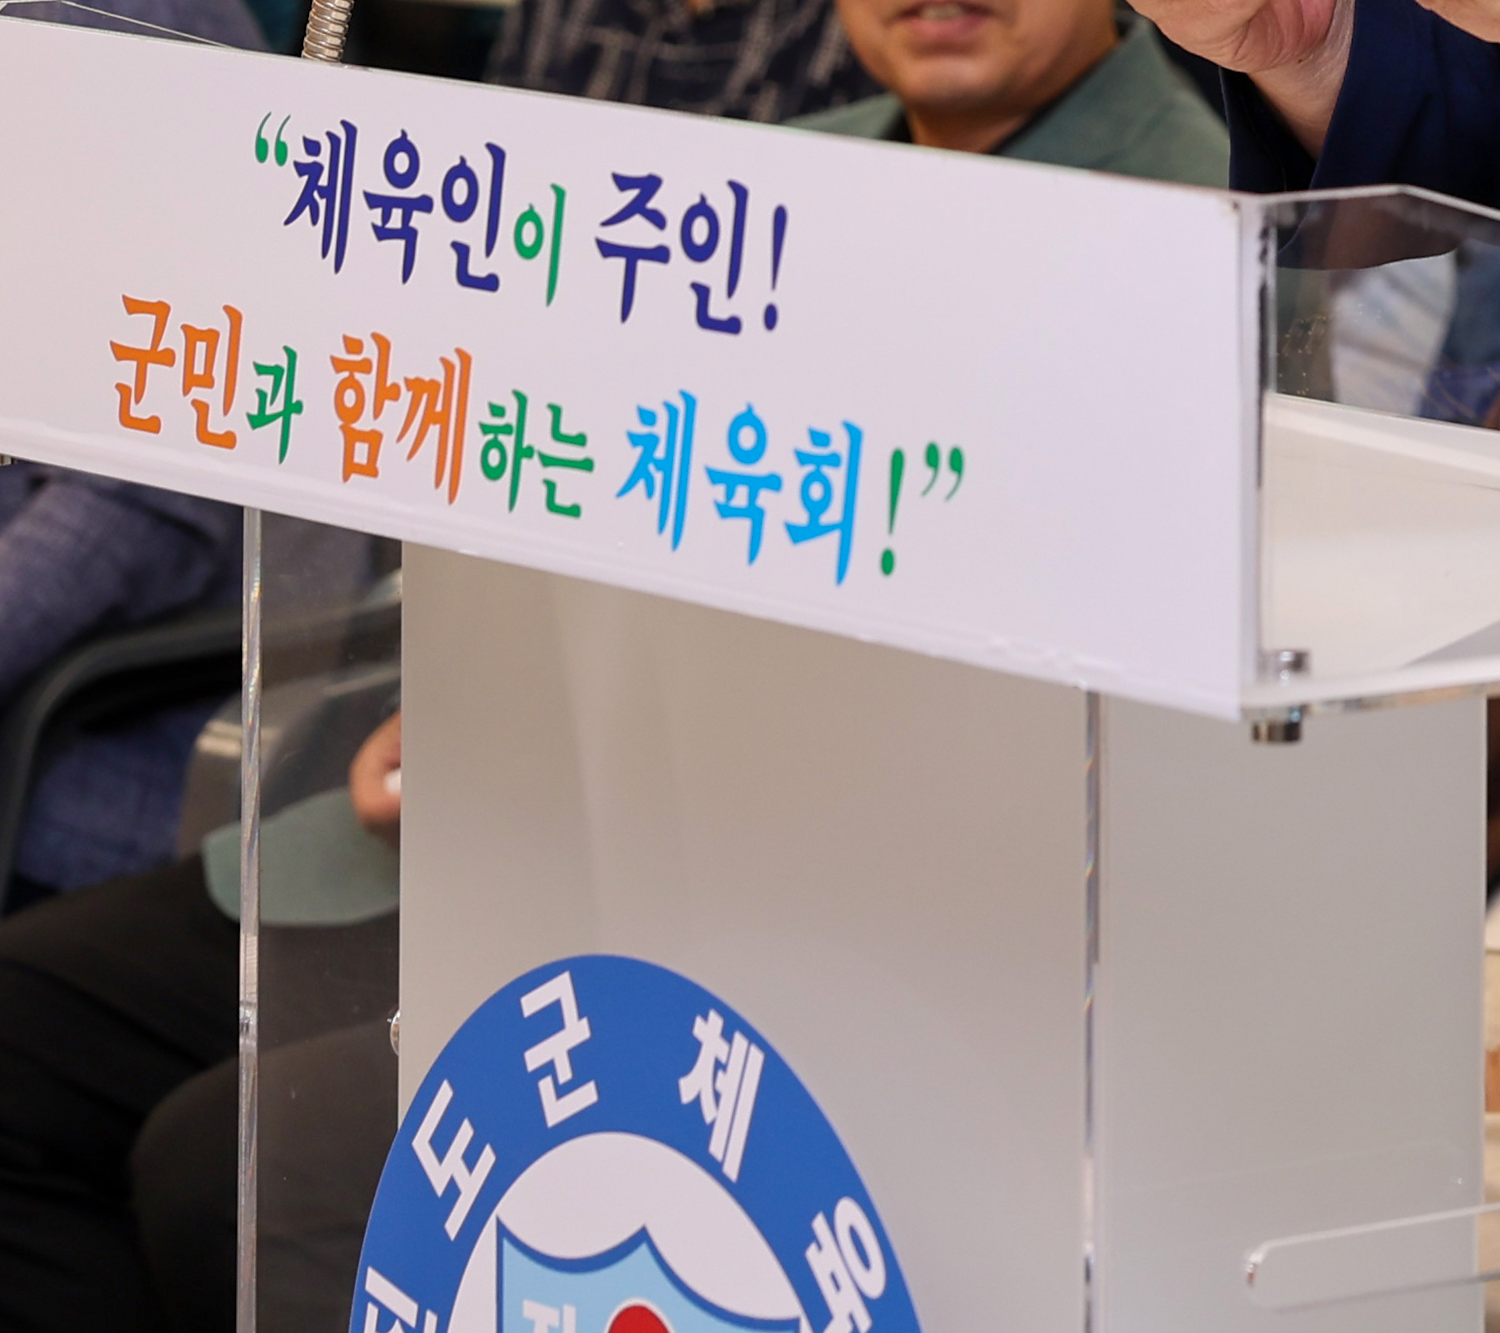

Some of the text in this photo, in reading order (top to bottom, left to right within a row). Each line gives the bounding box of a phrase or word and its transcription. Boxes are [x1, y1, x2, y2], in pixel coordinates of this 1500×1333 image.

[254, 113, 789, 335] “체육인이 주인!
[109, 294, 966, 587] 군민과 함께하는 체육회!”
